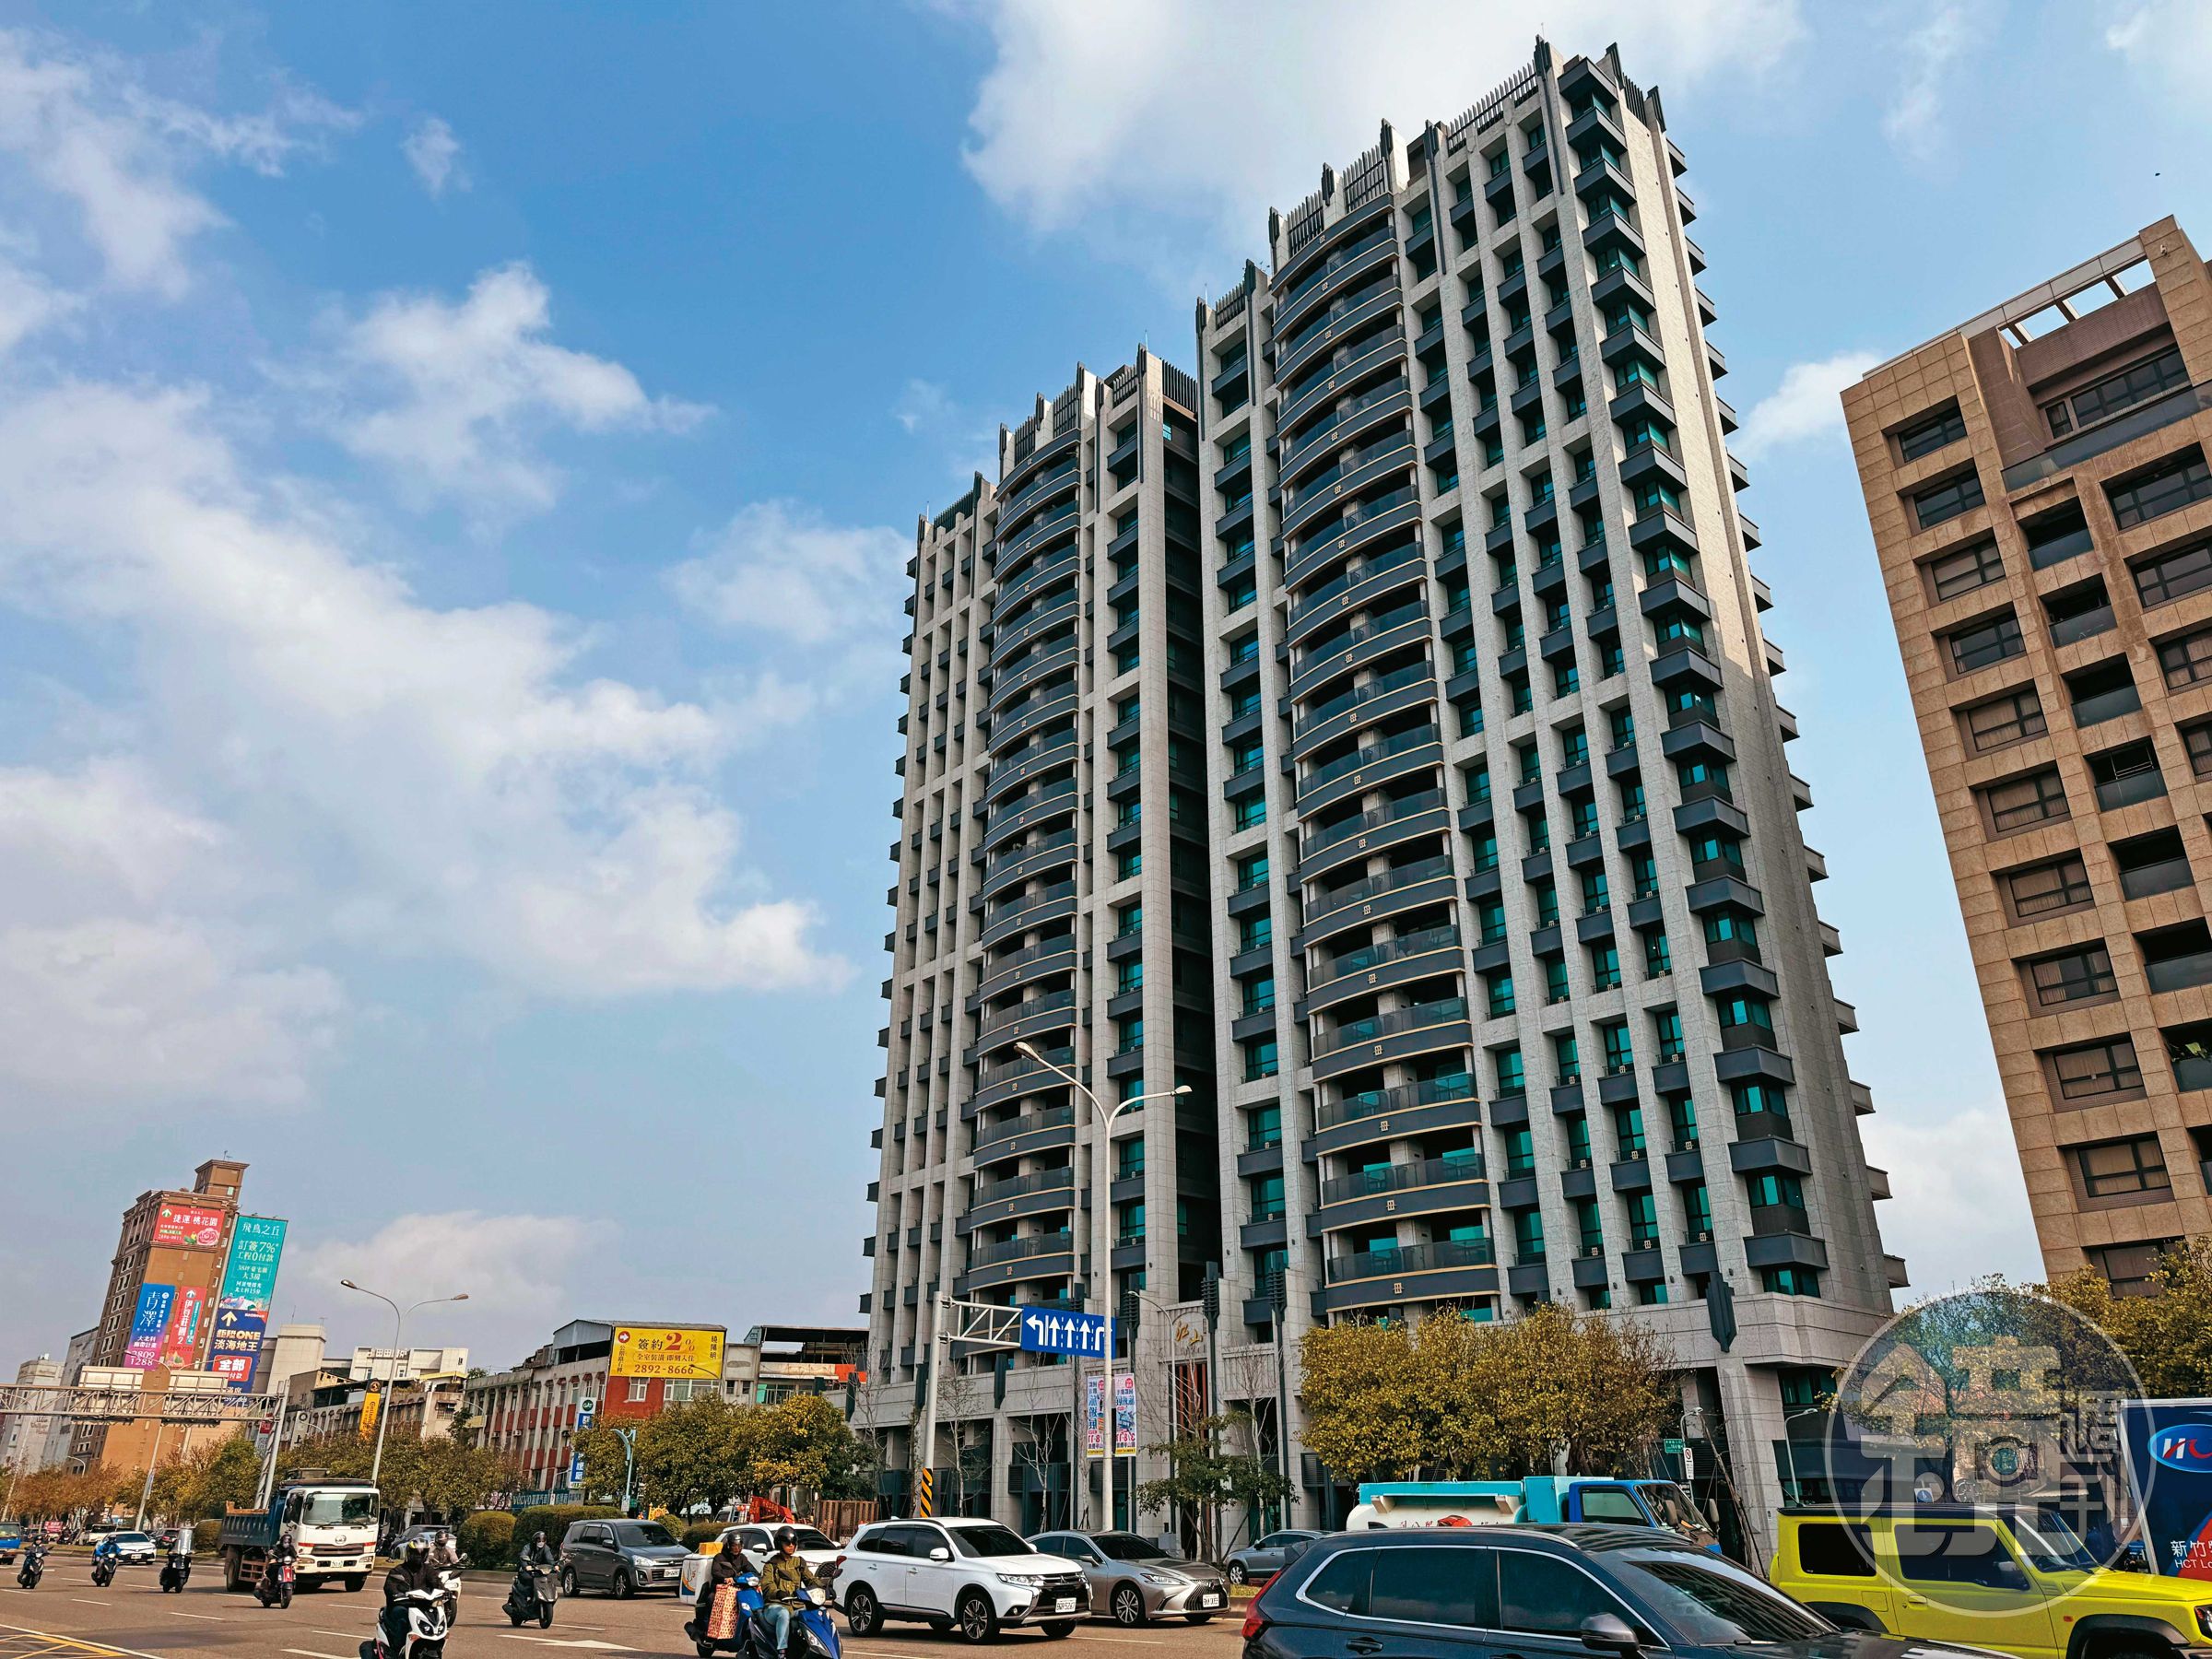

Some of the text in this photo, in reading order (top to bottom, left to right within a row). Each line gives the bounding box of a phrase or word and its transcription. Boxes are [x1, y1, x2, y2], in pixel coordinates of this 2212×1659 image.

[173, 1214, 191, 1224] 捷運
[193, 1217, 218, 1227] 桃花園
[242, 1222, 280, 1236] 飛鳥之丘
[140, 1291, 160, 1327] 青澤
[214, 1338, 258, 1352] 淡海地王
[218, 1359, 246, 1371] 全部
[634, 1364, 694, 1375] 2892-8666
[2171, 1540, 2212, 1558] 新竹
[2174, 1559, 2197, 1569] HCT
